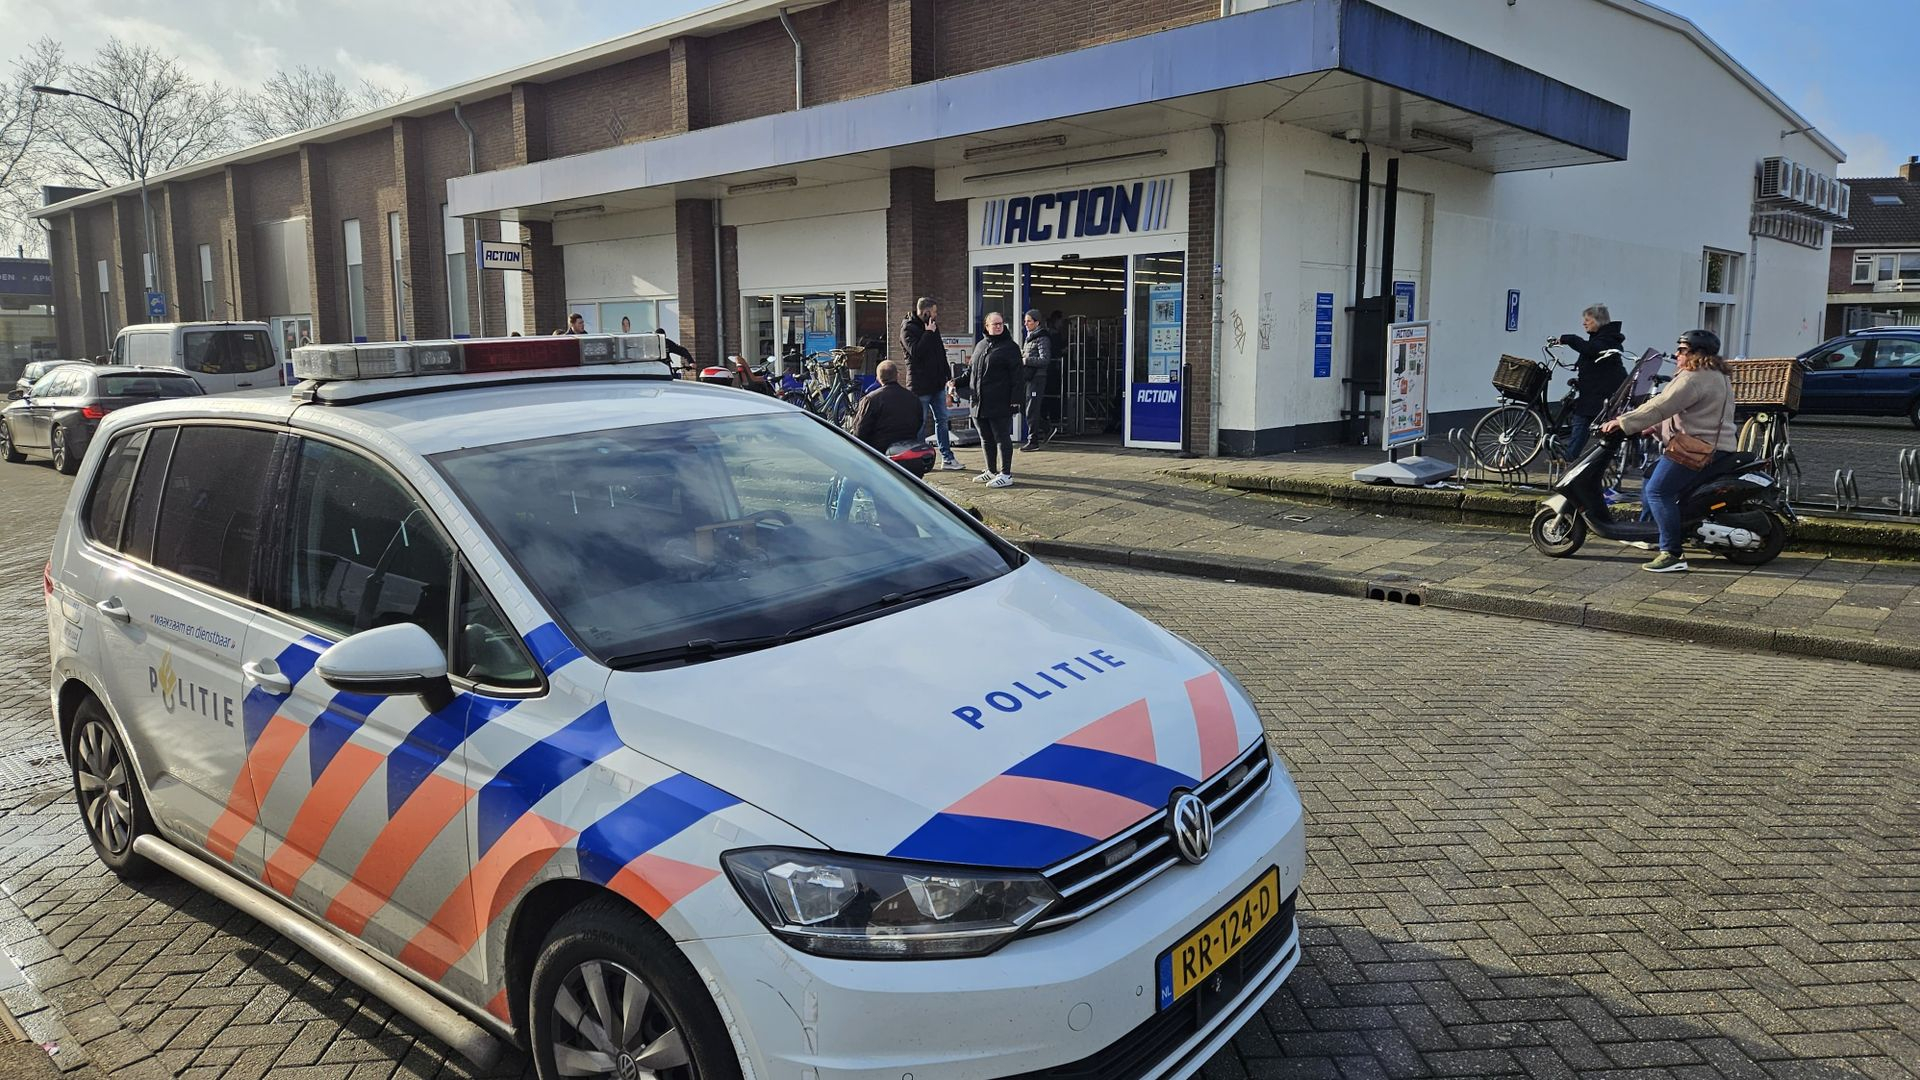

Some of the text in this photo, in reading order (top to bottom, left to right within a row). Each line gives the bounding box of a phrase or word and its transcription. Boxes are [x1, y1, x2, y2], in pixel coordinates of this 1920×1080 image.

[1004, 182, 1143, 244] ACTION
[485, 250, 520, 262] ACTION
[0, 273, 15, 281] EN
[1511, 293, 1518, 313] P
[1396, 329, 1413, 338] ACTION
[1137, 389, 1177, 403] ACTION
[186, 624, 195, 636] en
[195, 626, 231, 648] dienstbaar
[951, 649, 1126, 730] POLITIE
[1183, 885, 1270, 986] RR-124-D
[1161, 985, 1172, 999] NL
